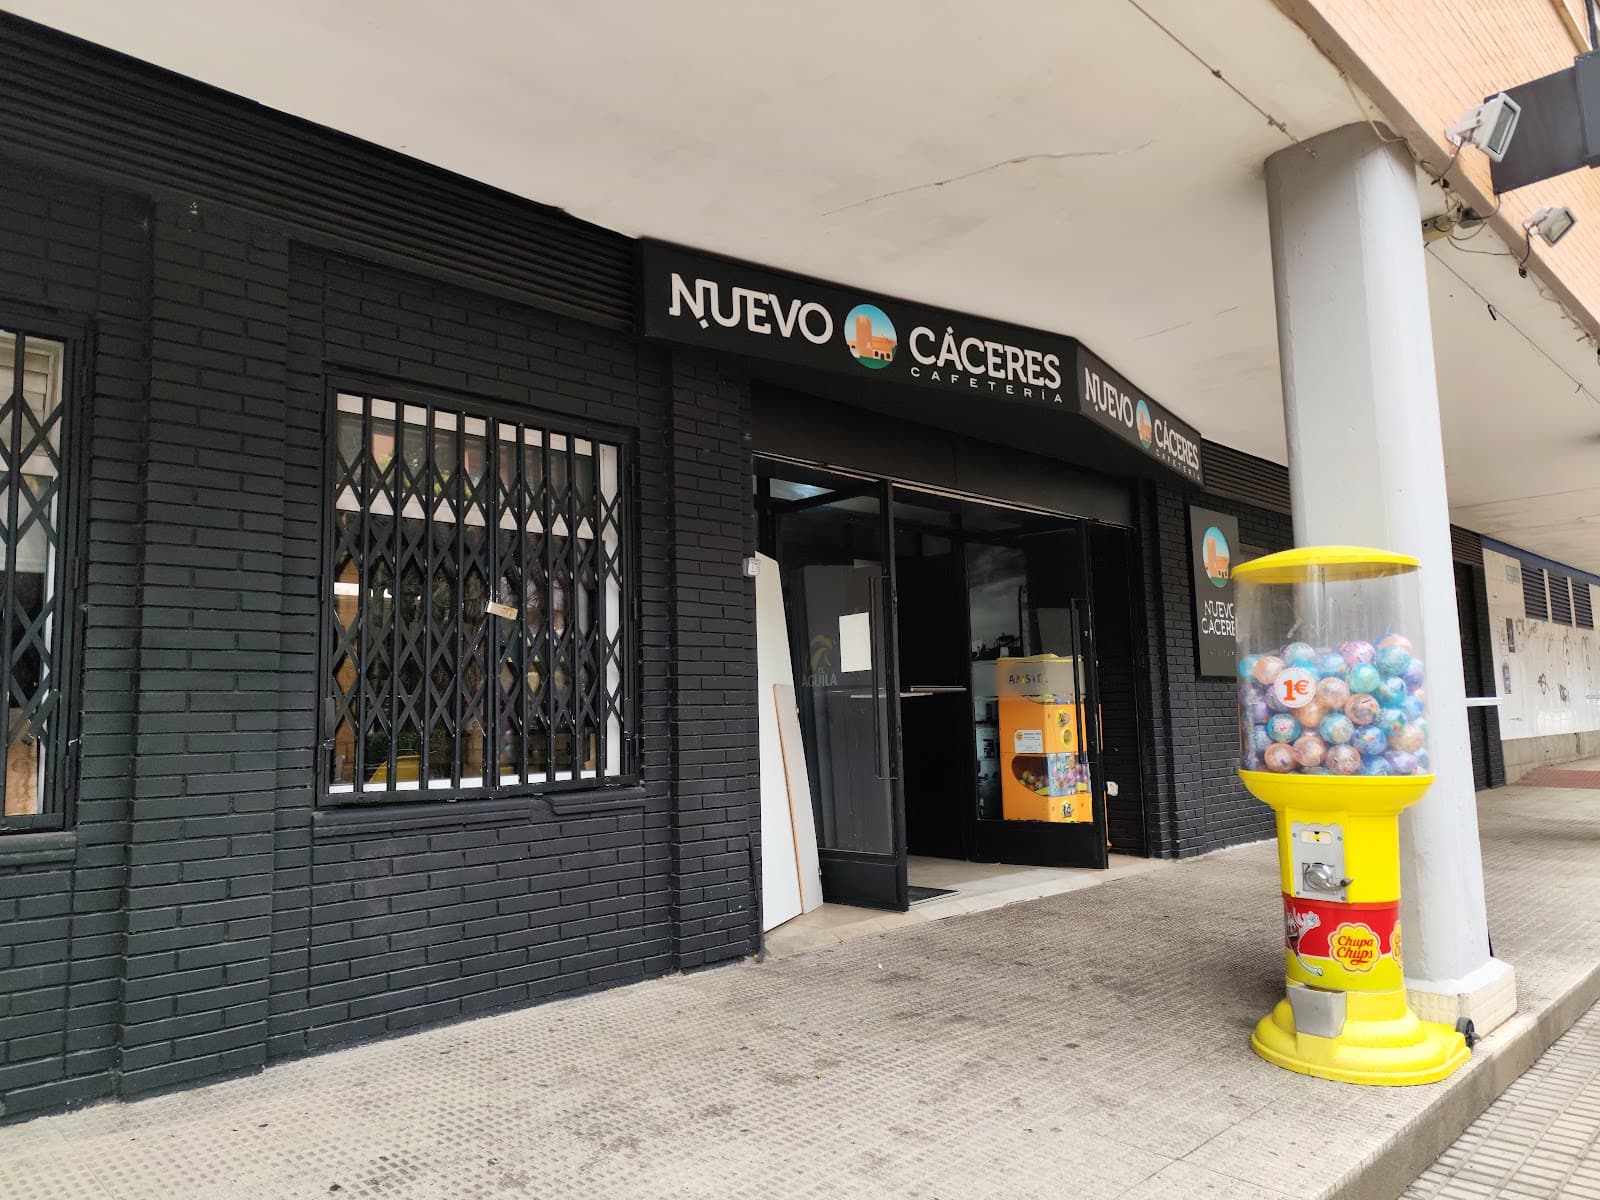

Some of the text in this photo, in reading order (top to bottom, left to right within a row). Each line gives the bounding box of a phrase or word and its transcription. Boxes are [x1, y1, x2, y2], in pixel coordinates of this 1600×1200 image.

[669, 272, 1062, 390] NUEVO CÁCERES
[910, 366, 1063, 404] CAFETERÍA
[1085, 368, 1200, 471] NUEVO CÁCERES
[1283, 679, 1310, 701] 1€
[1336, 946, 1373, 966] Chups
[1337, 935, 1373, 951] Chupa
